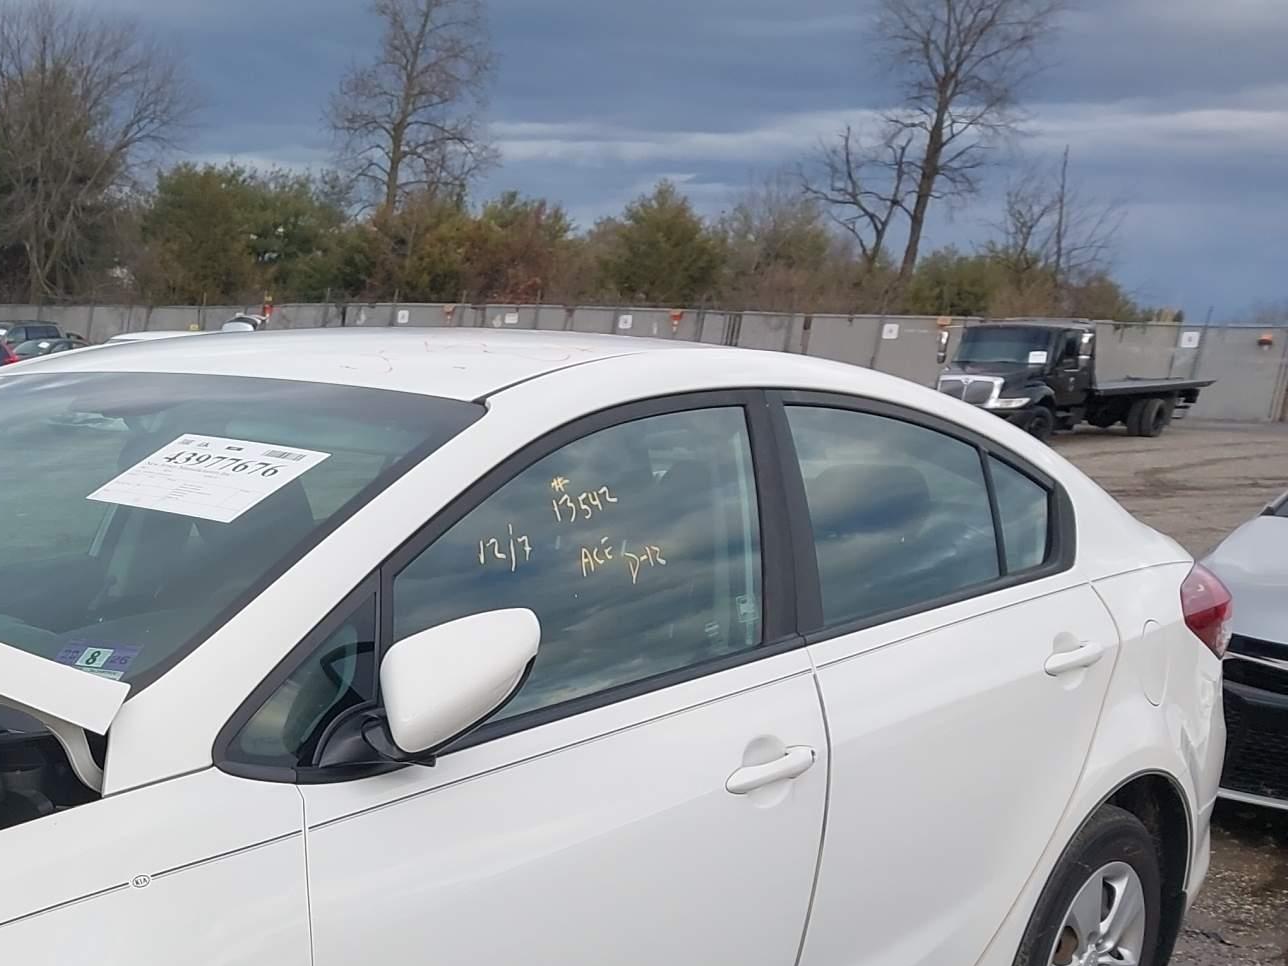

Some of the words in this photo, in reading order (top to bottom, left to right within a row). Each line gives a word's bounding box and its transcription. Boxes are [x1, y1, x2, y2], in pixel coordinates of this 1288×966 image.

[163, 450, 286, 478] 43977676
[478, 523, 532, 572] 12/7
[85, 650, 101, 665] 8
